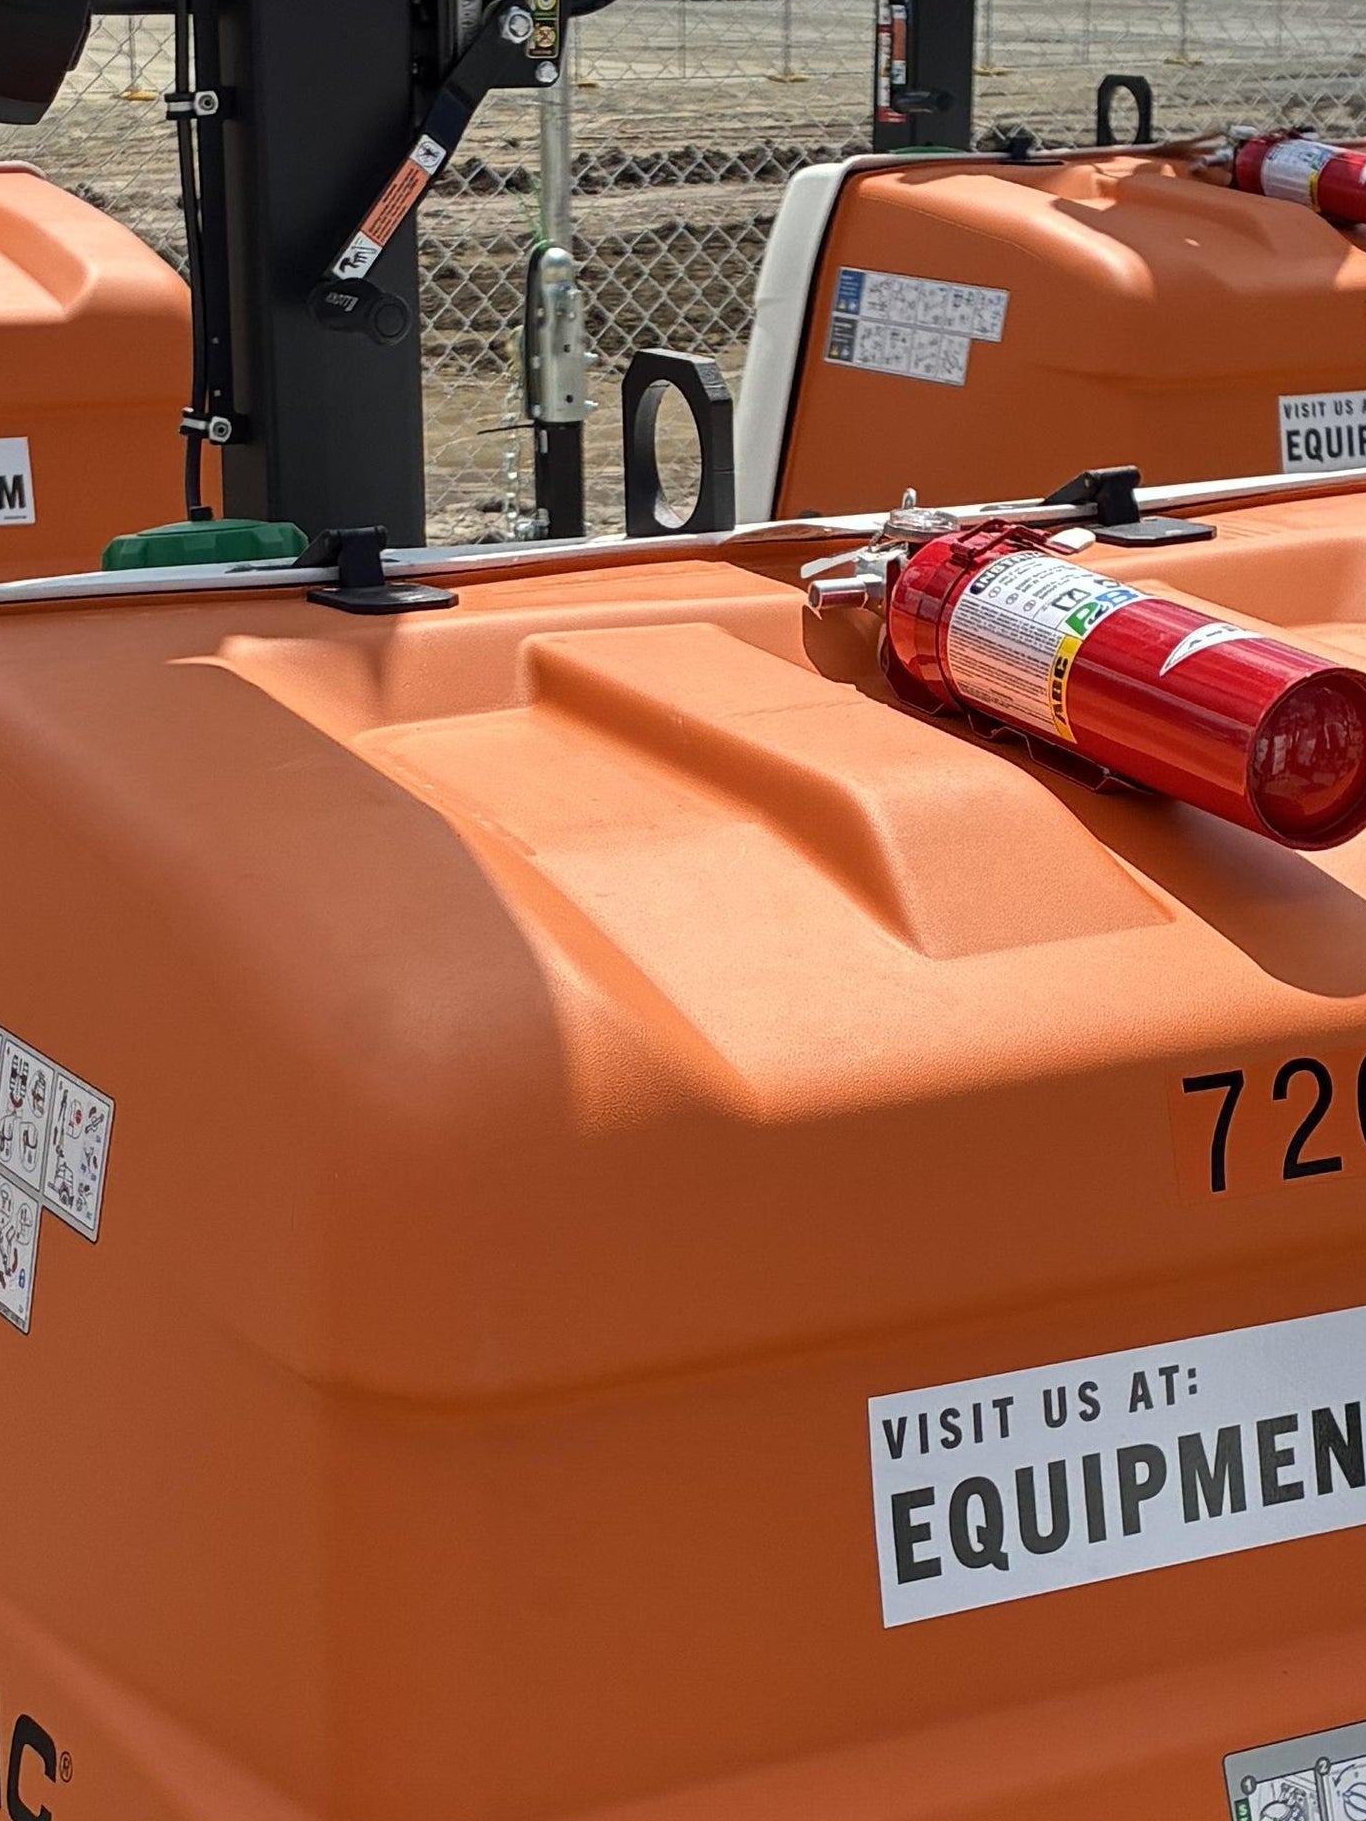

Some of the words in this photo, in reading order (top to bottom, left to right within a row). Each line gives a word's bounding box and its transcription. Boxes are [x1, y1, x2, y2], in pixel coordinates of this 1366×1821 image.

[1283, 401, 1324, 419] VISIT
[1335, 400, 1354, 416] US
[1053, 654, 1069, 725] ABC
[883, 1396, 1014, 1460] VISIT
[1043, 1381, 1101, 1429] US
[1128, 1363, 1198, 1414] AT:
